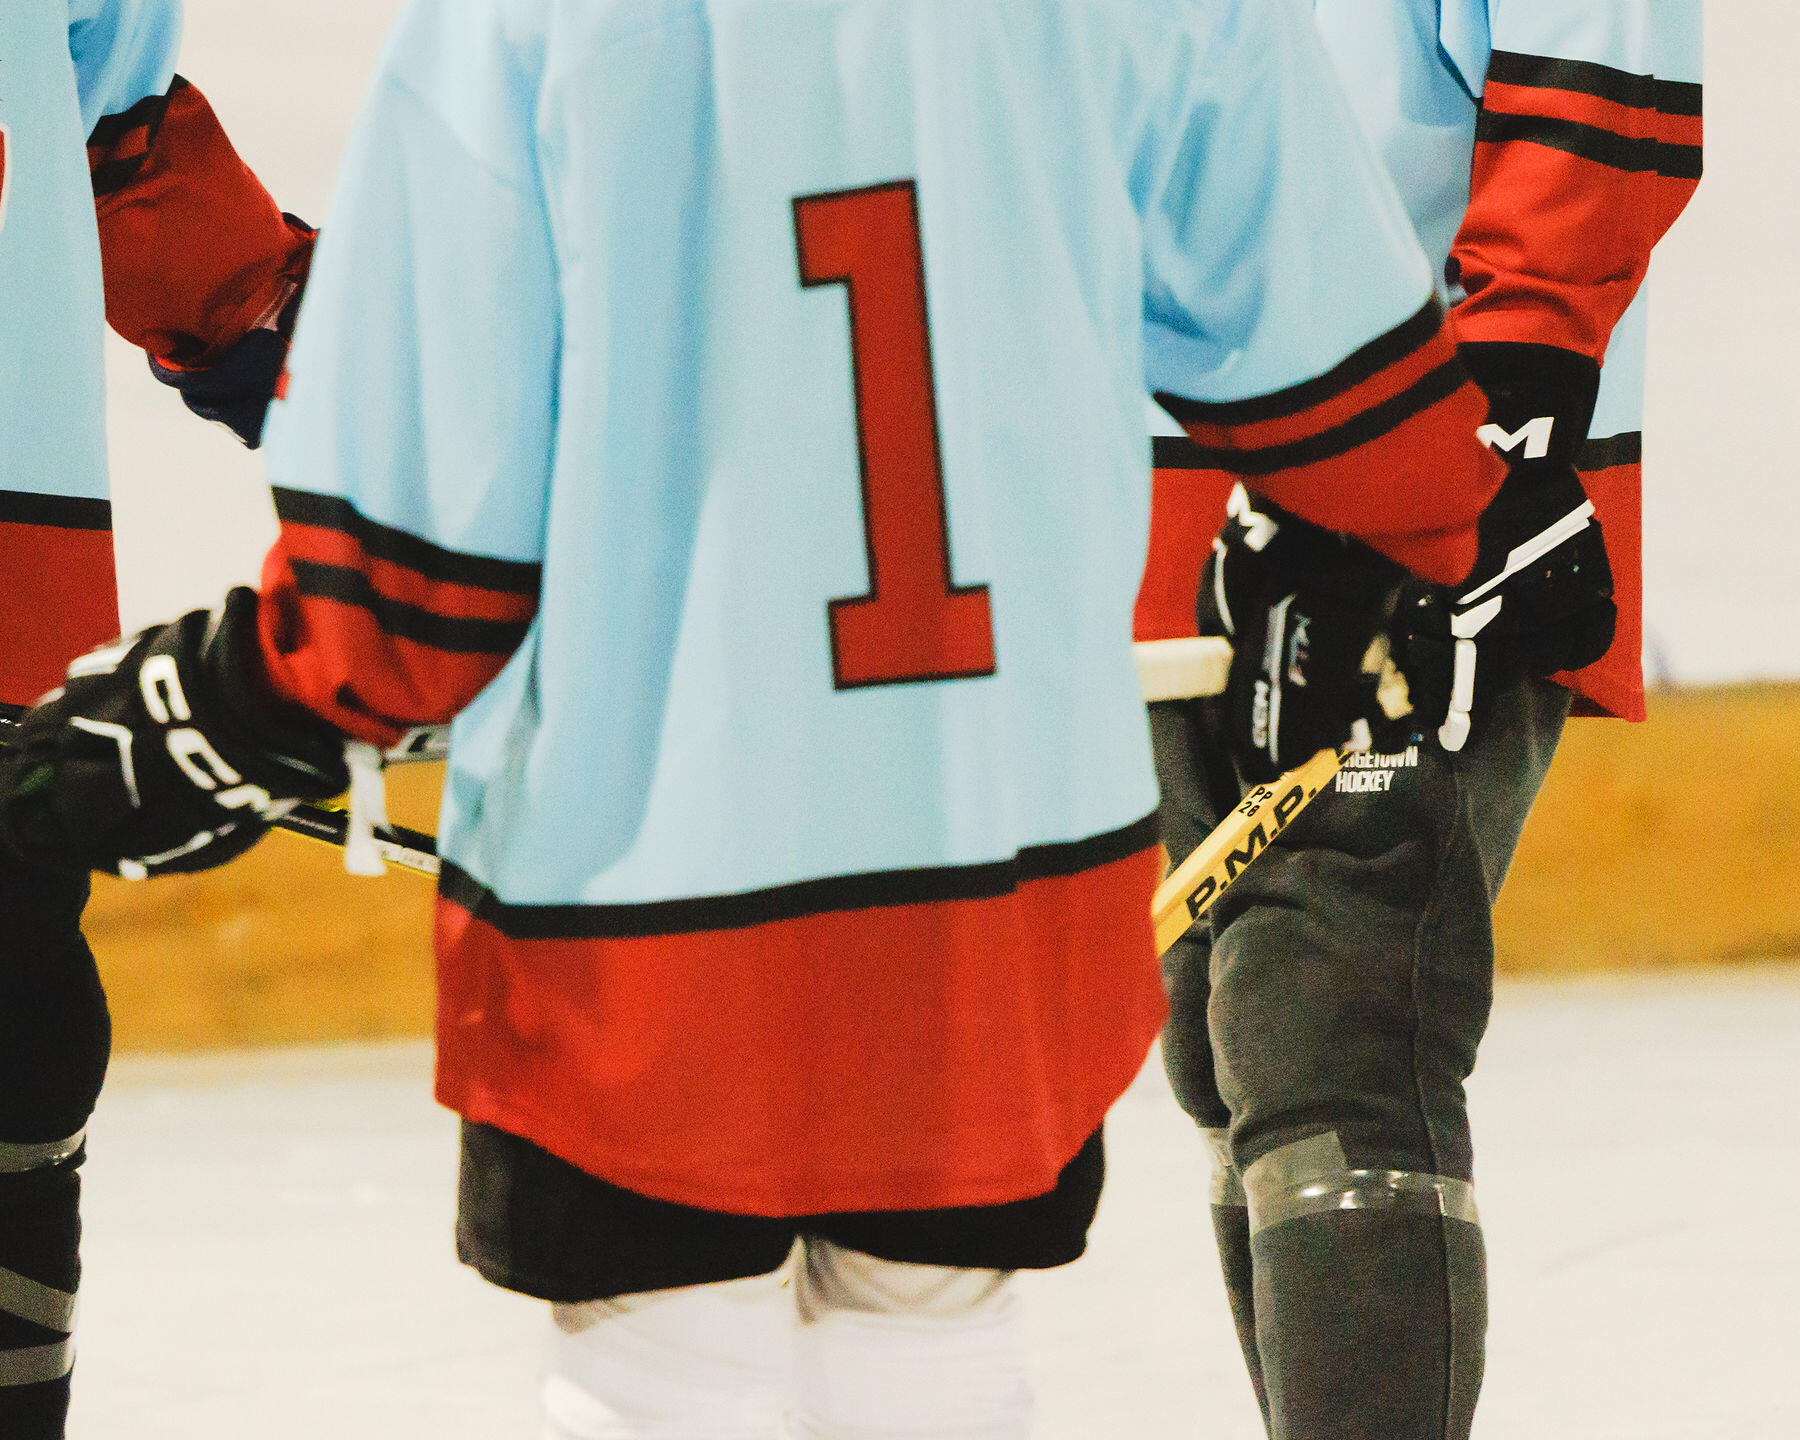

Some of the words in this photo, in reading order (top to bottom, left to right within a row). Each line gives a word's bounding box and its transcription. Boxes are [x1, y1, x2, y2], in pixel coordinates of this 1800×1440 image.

[791, 178, 998, 694] 1
[1251, 786, 1273, 803] PP
[1335, 770, 1395, 793] HOCKEY
[1185, 785, 1317, 920] P.M.P.
